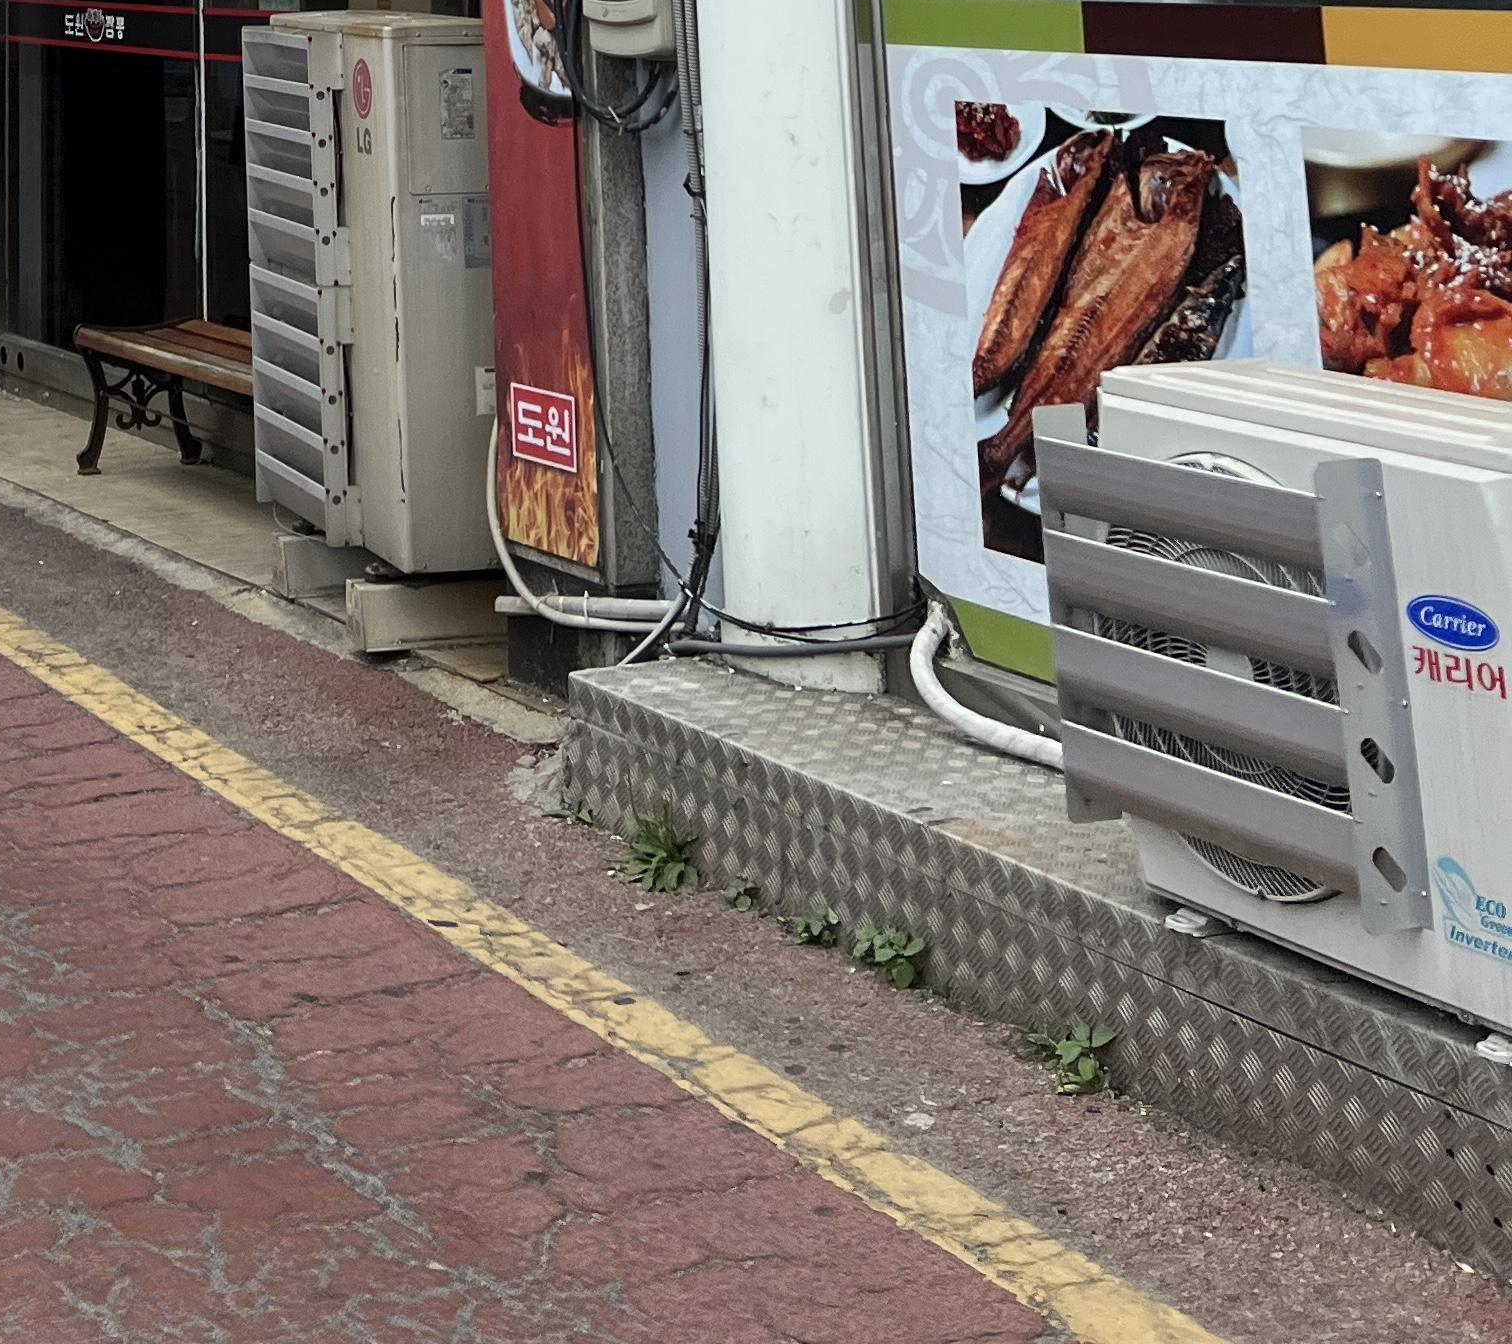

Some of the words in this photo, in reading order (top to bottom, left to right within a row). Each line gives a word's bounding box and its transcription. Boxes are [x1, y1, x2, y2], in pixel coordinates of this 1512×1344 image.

[356, 128, 373, 156] LG
[516, 401, 571, 457] 도원
[1419, 605, 1487, 639] Carrier
[1414, 645, 1507, 700] 캐리어
[1476, 895, 1507, 919] ECO
